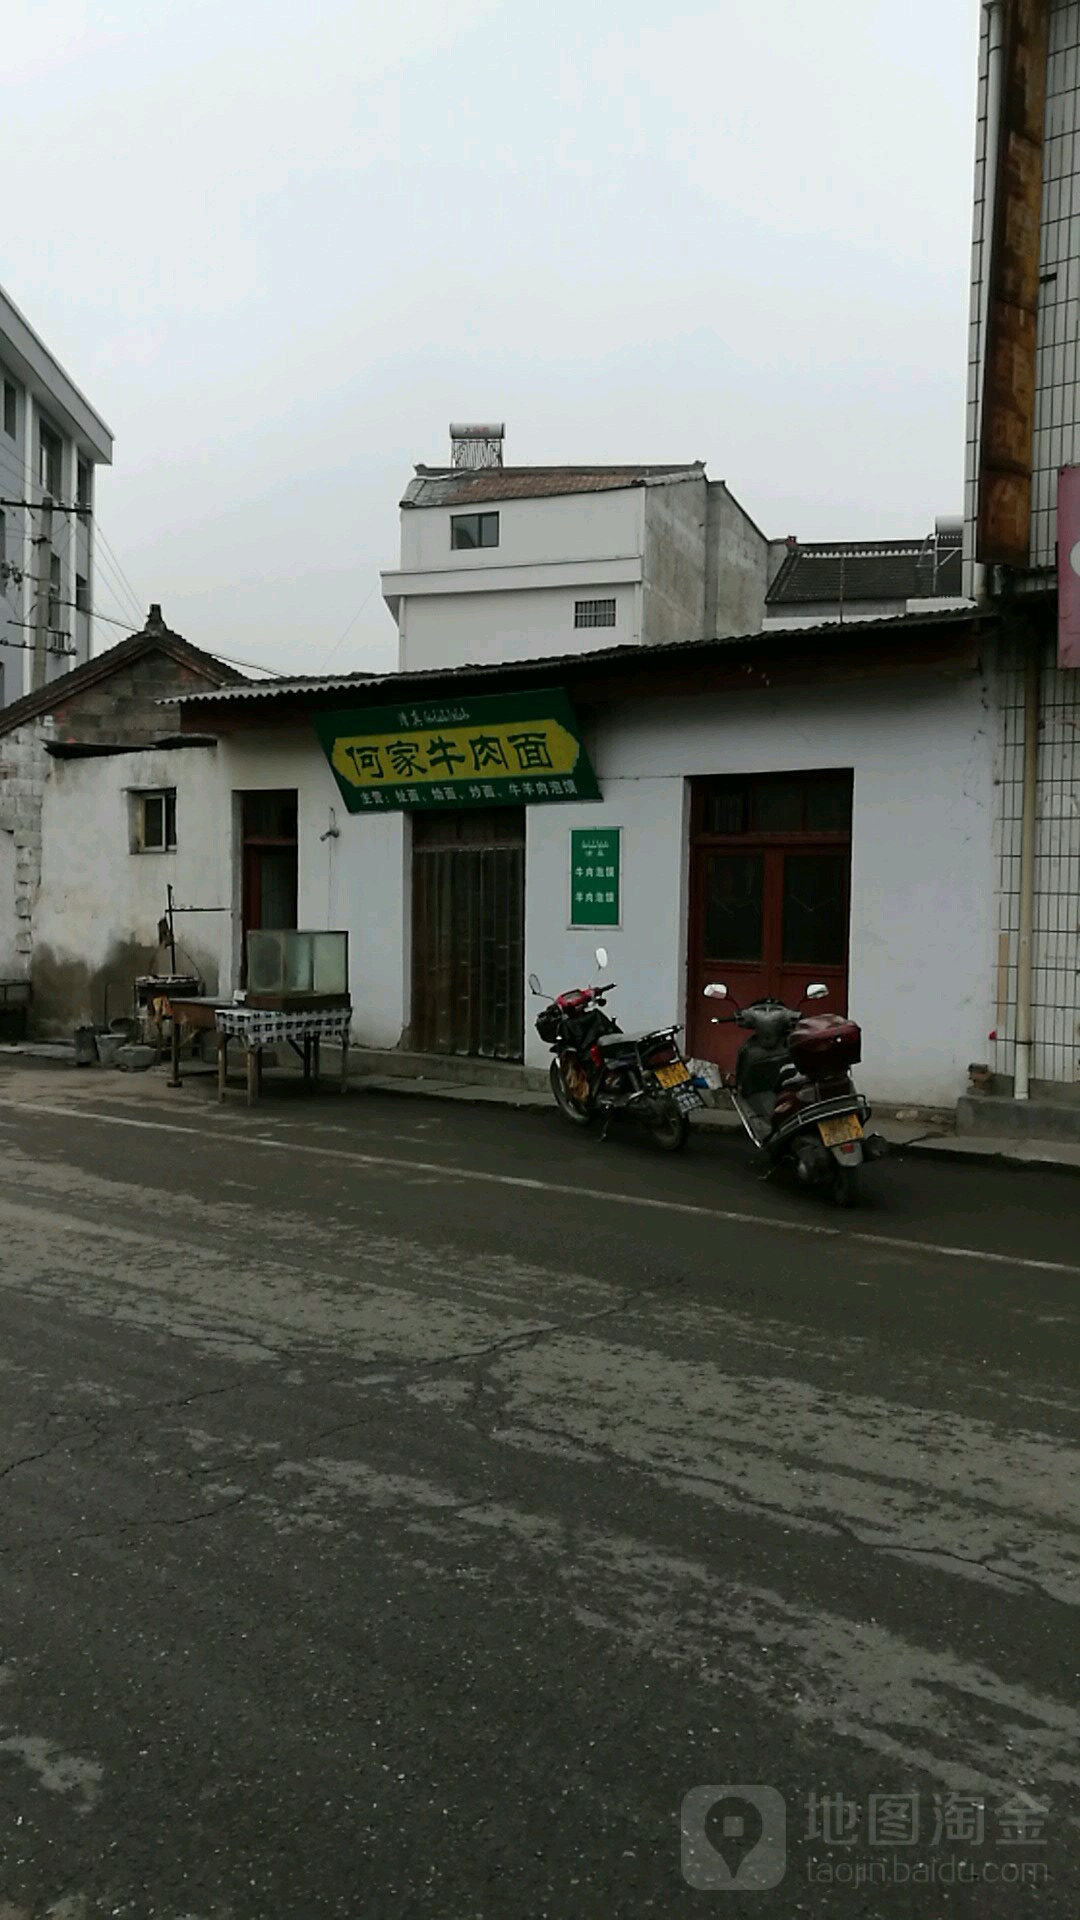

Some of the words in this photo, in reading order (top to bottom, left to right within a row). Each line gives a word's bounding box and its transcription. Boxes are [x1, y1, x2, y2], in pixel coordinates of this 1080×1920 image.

[346, 732, 554, 779] 何家牛肉面
[575, 866, 615, 878] 牛肉泡馍
